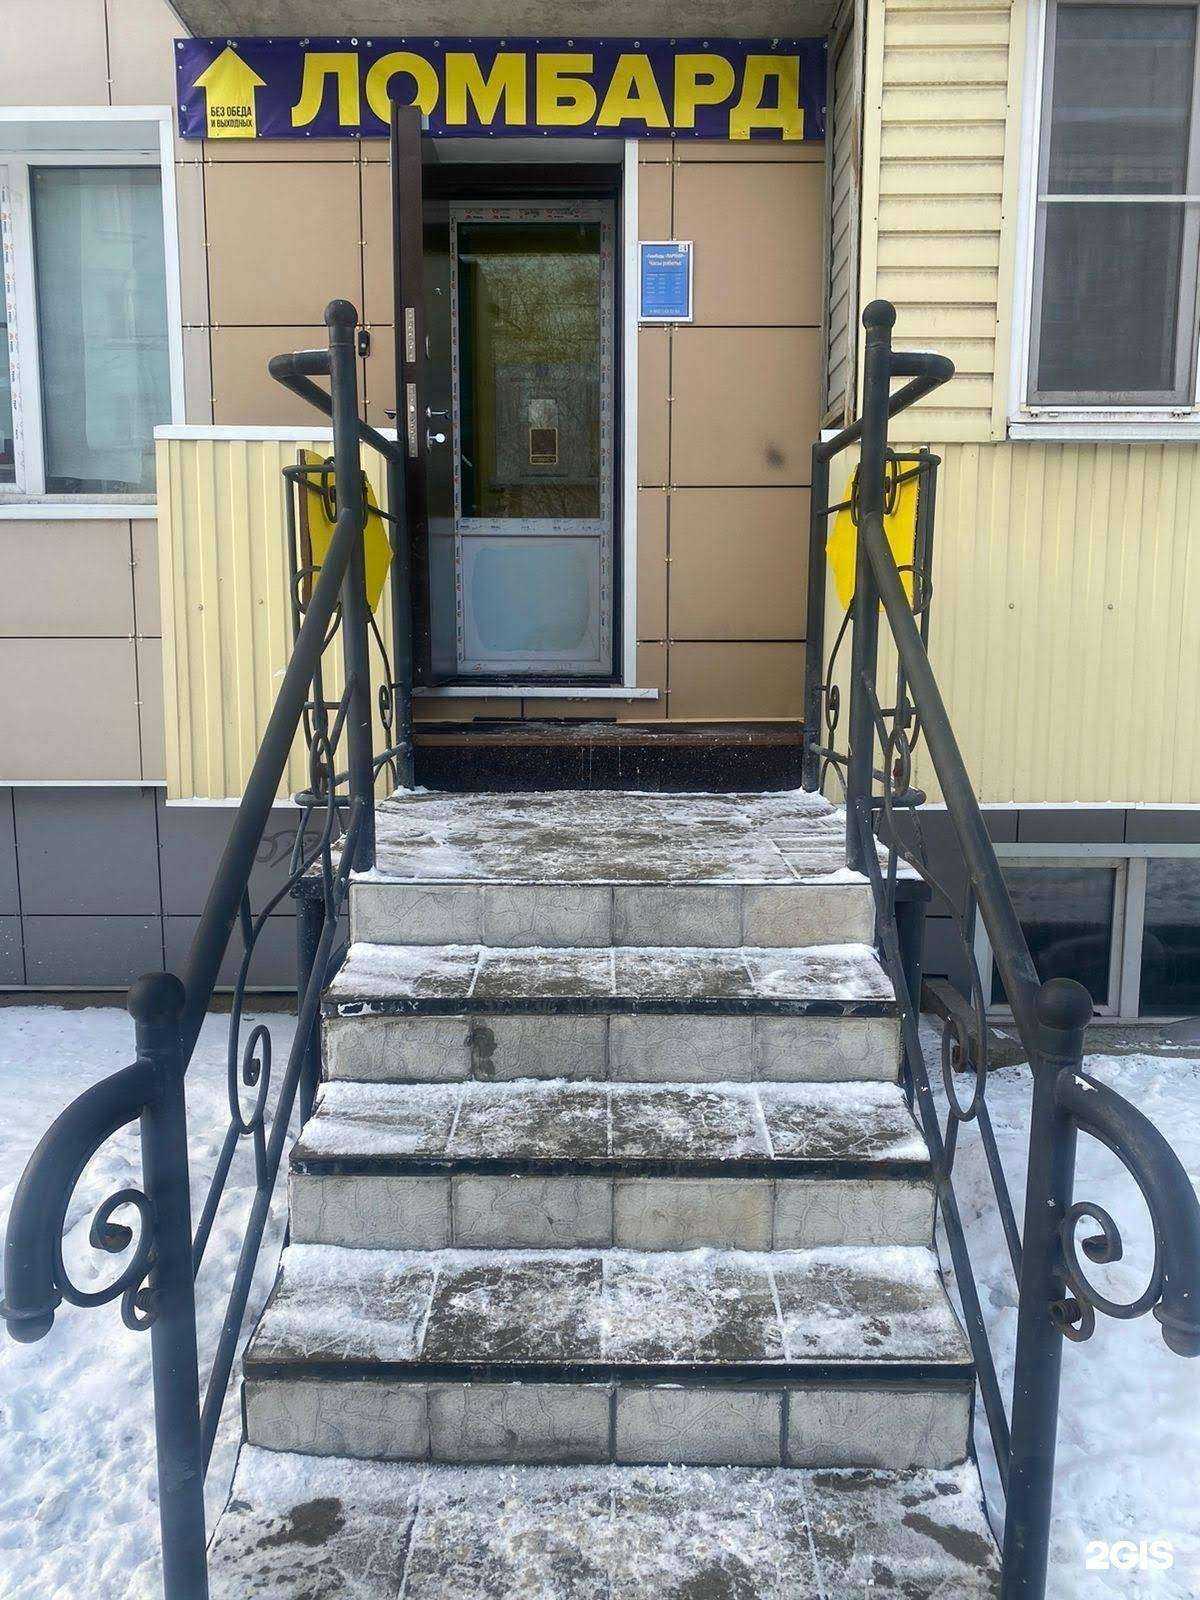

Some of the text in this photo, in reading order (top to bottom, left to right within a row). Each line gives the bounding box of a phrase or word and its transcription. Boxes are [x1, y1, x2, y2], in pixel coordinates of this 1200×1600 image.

[291, 52, 803, 140] ЛОМБАРД
[210, 106, 252, 117] БЕЗ ОБЕДА
[211, 119, 253, 128] И ВЫХОДНЫХ
